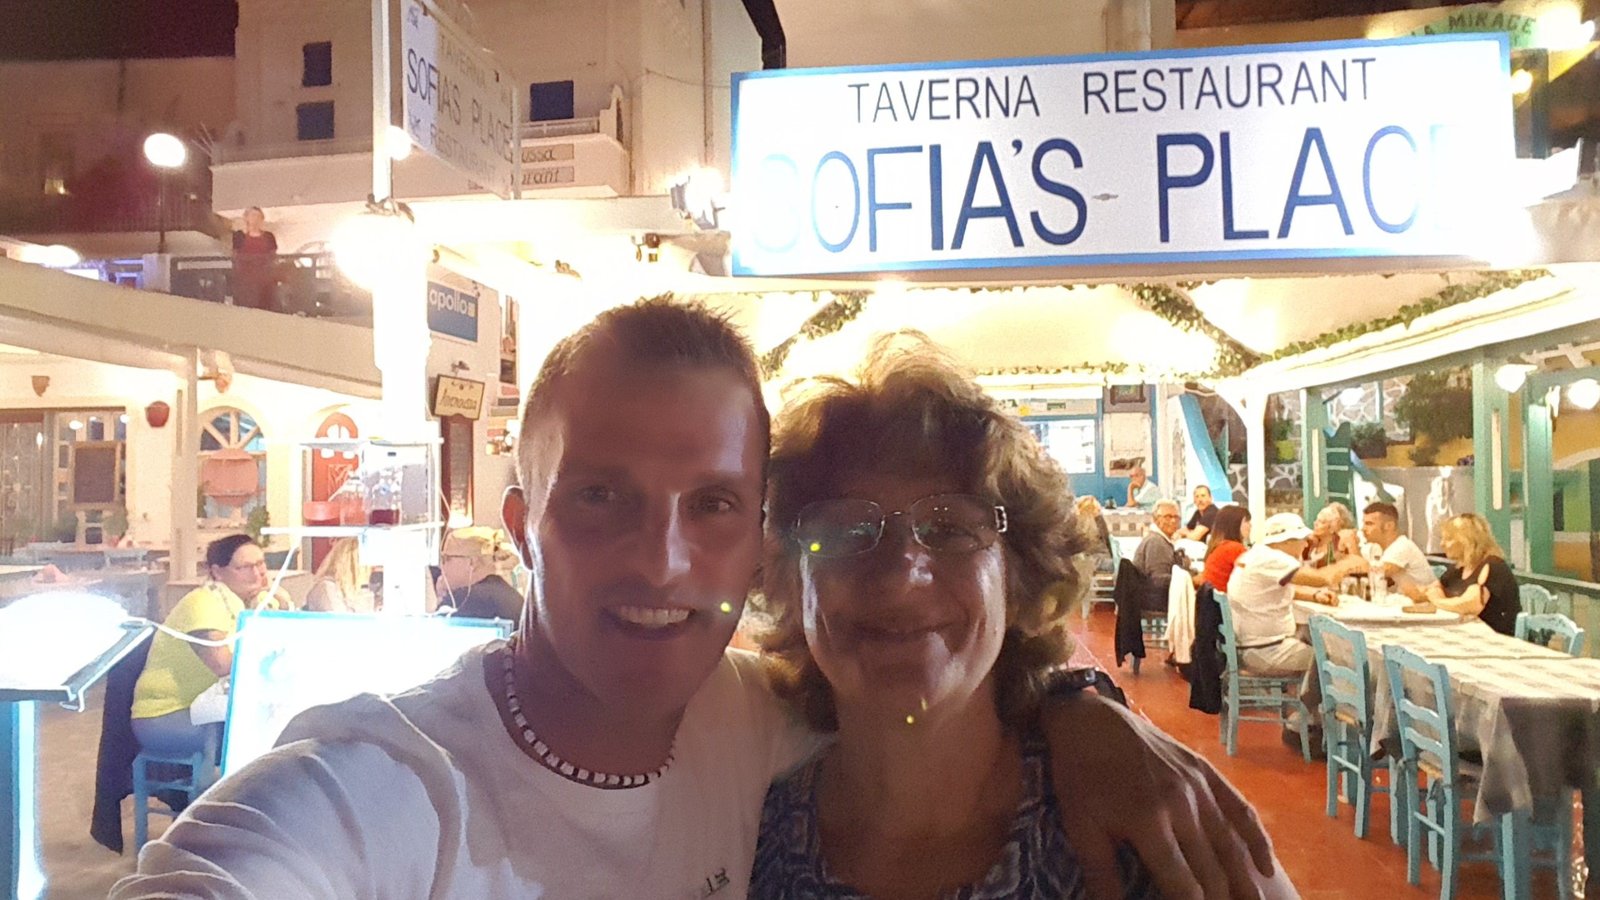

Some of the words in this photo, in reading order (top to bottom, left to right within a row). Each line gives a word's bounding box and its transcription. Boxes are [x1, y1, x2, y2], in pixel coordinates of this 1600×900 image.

[1449, 11, 1537, 34] MIRAGE
[848, 74, 1040, 123] TAVERNA
[1083, 58, 1376, 115] RESTAURANT
[471, 97, 515, 164] PLACE
[429, 289, 467, 315] apollo
